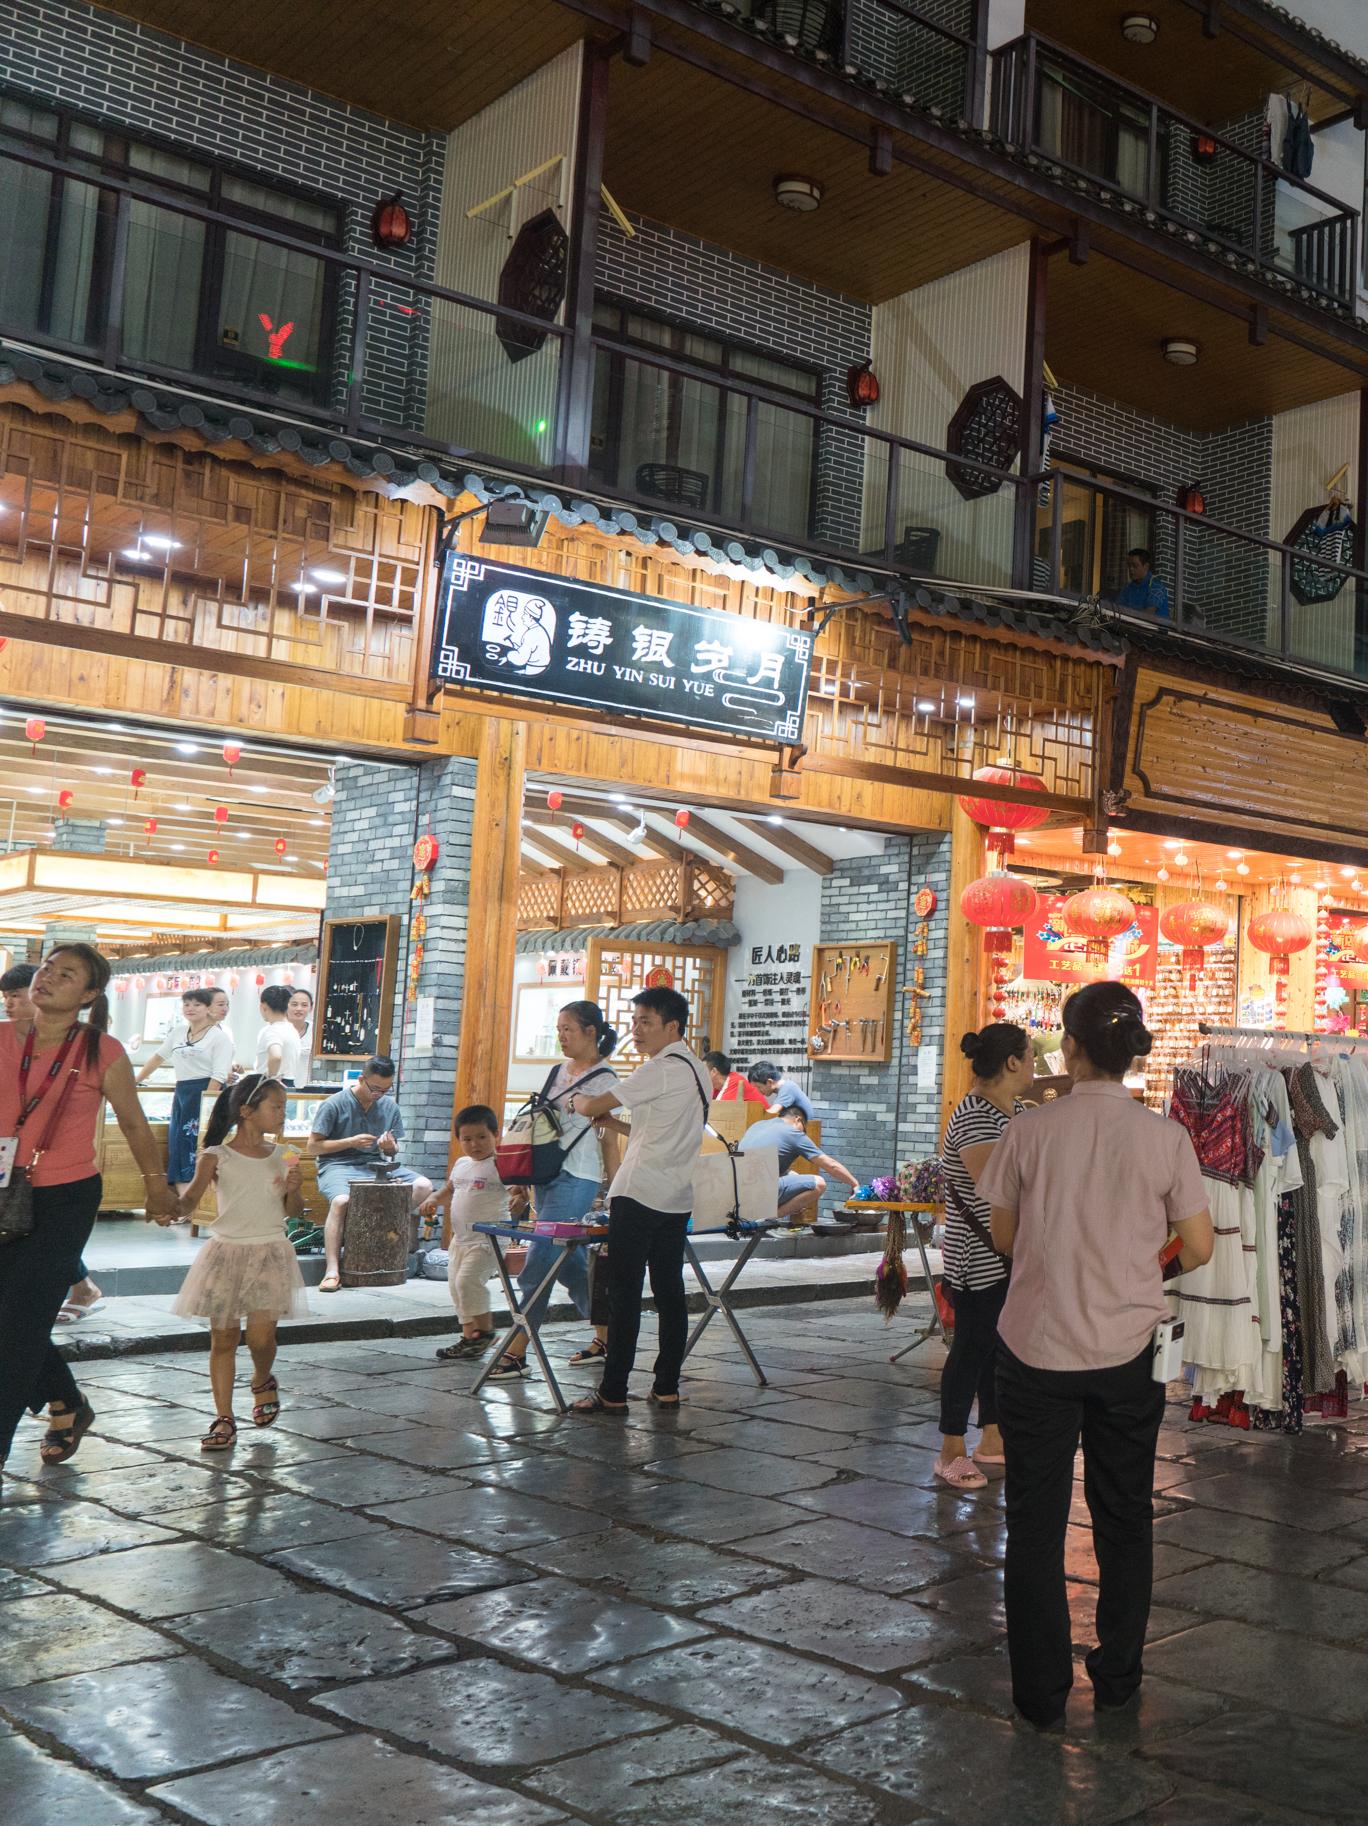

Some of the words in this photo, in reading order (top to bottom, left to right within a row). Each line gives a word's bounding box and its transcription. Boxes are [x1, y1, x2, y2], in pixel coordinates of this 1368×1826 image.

[566, 611, 785, 689] 铸银岁月
[565, 656, 606, 676] ZHU
[613, 664, 644, 682] YIN
[648, 671, 676, 689] SUI
[682, 677, 715, 698] YUE
[752, 943, 801, 965] 匠人心路
